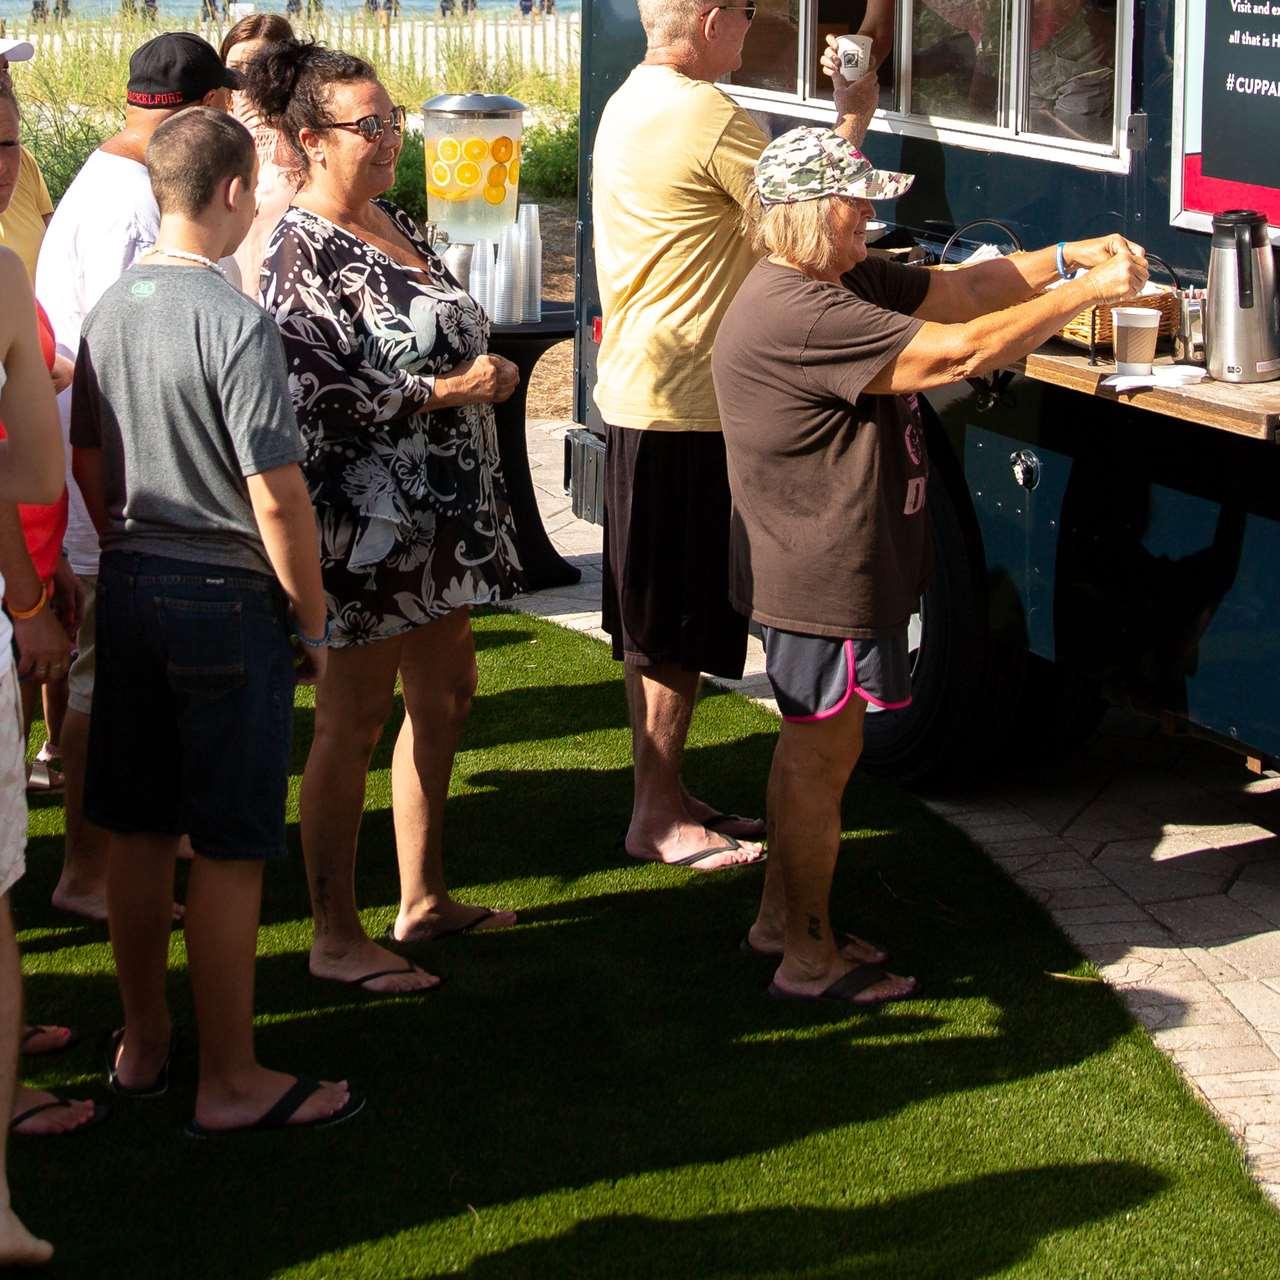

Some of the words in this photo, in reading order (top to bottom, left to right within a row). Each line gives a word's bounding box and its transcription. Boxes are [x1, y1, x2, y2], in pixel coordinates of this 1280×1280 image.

[1252, 1, 1270, 15] and
[1228, 30, 1240, 44] all
[1241, 31, 1260, 46] that
[1262, 33, 1270, 47] is
